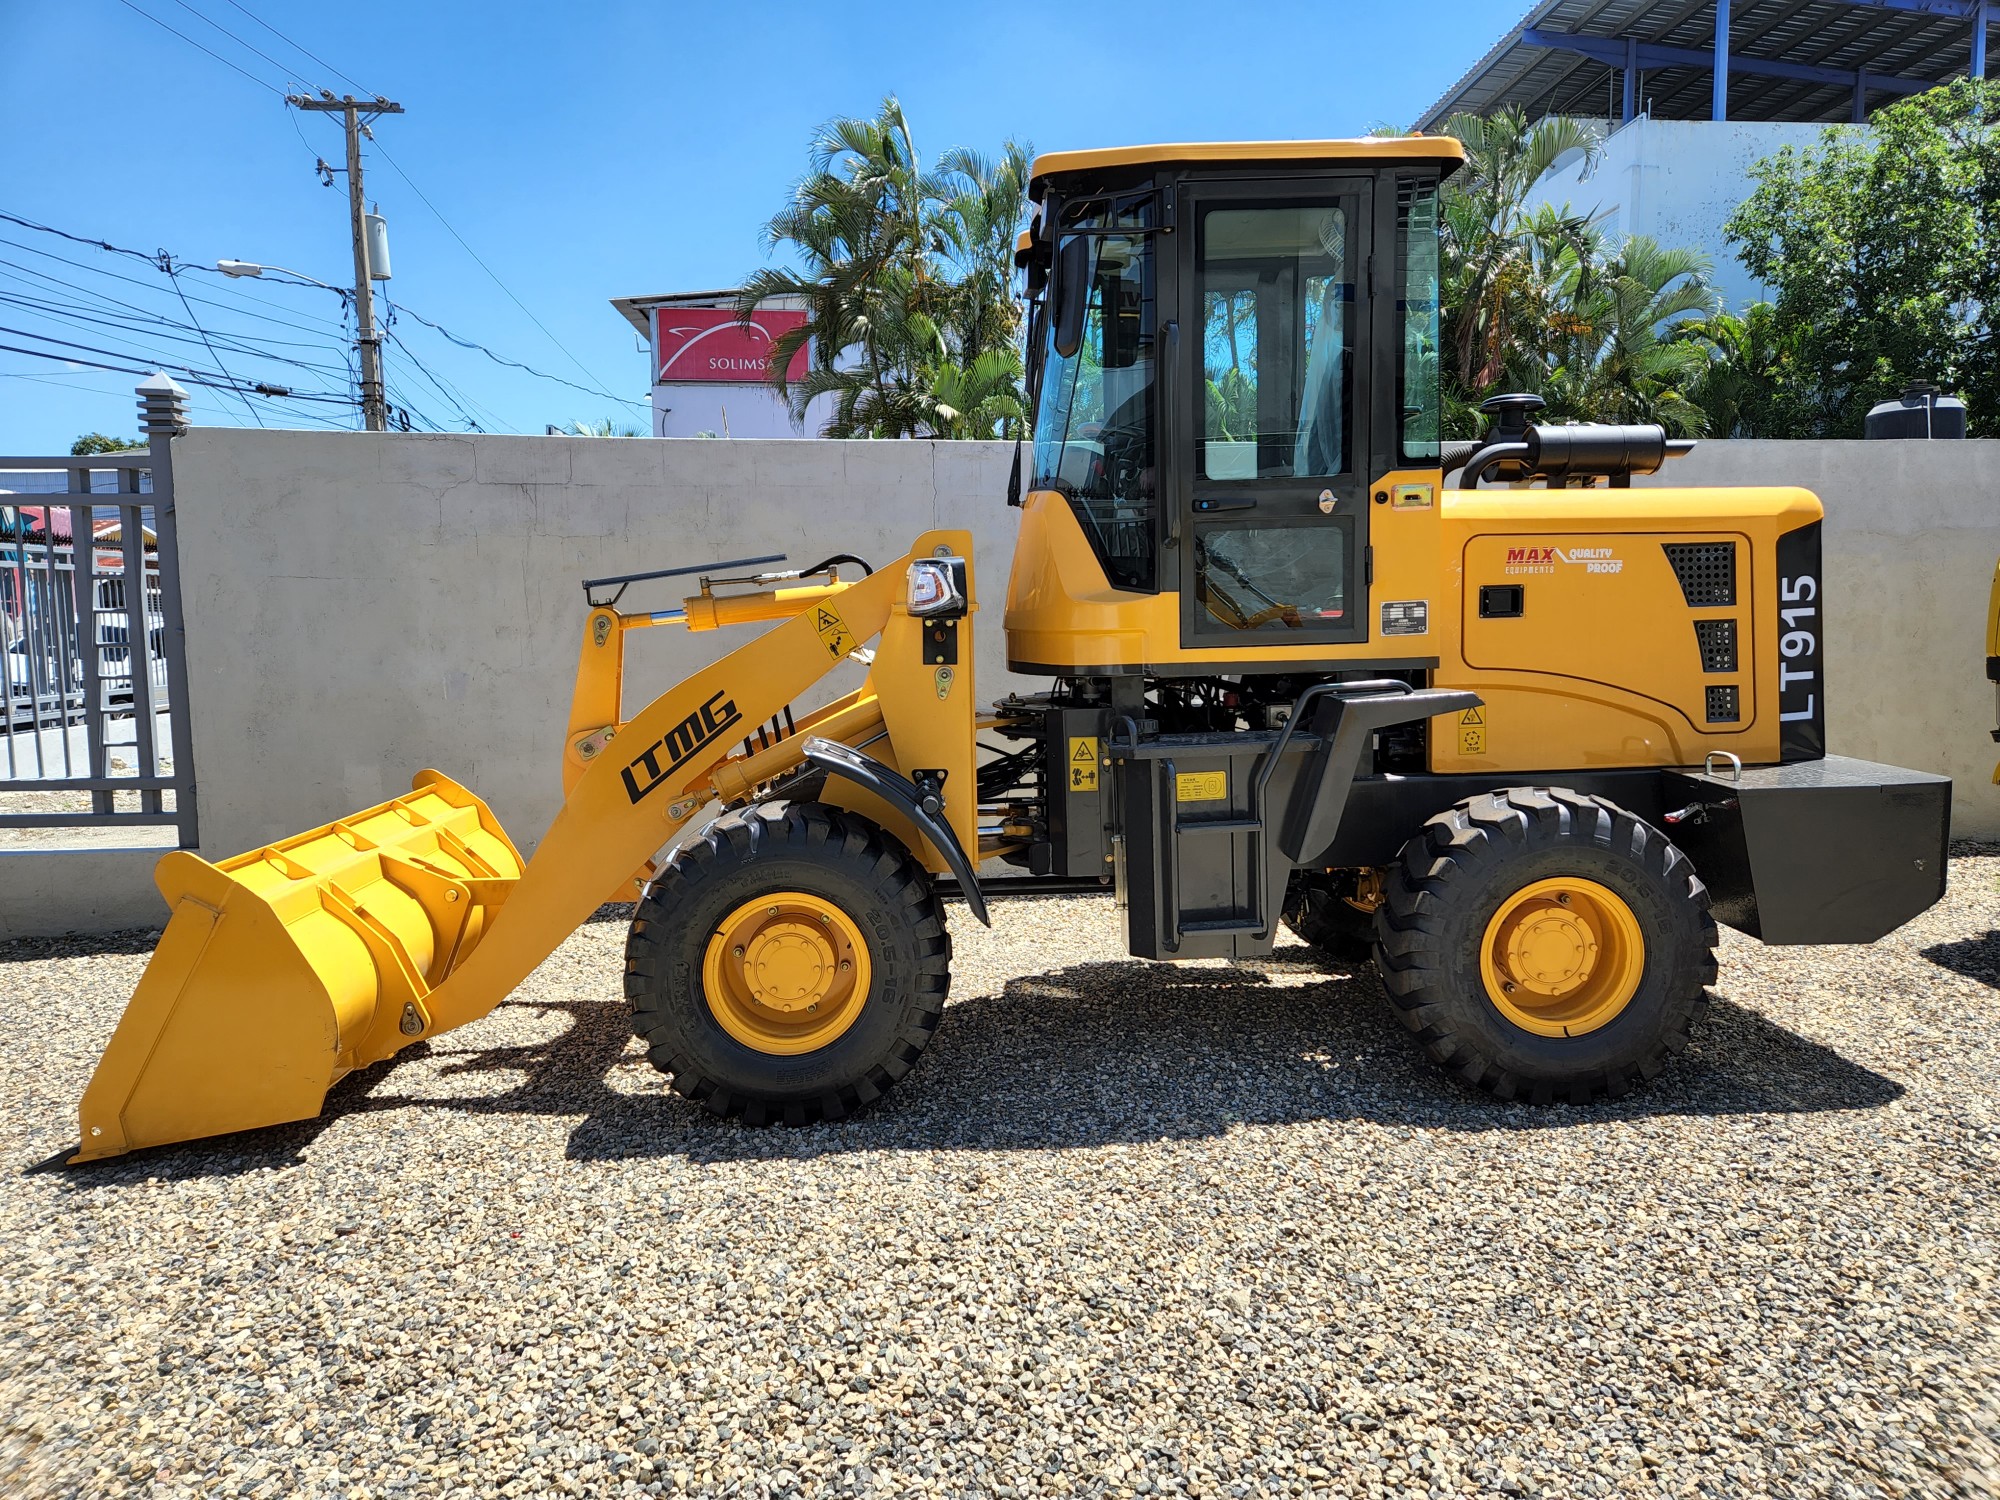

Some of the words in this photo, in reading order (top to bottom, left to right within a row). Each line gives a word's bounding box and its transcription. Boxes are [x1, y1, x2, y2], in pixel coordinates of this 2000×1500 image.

[1506, 546, 1556, 565] MAX
[1569, 548, 1613, 560] QUALITY
[1505, 565, 1555, 574] EQUIPMENTS
[1587, 563, 1623, 574] PROOF
[1779, 575, 1816, 722] LT915
[620, 689, 743, 805] LTMG
[865, 909, 898, 1005] 20.5-16
